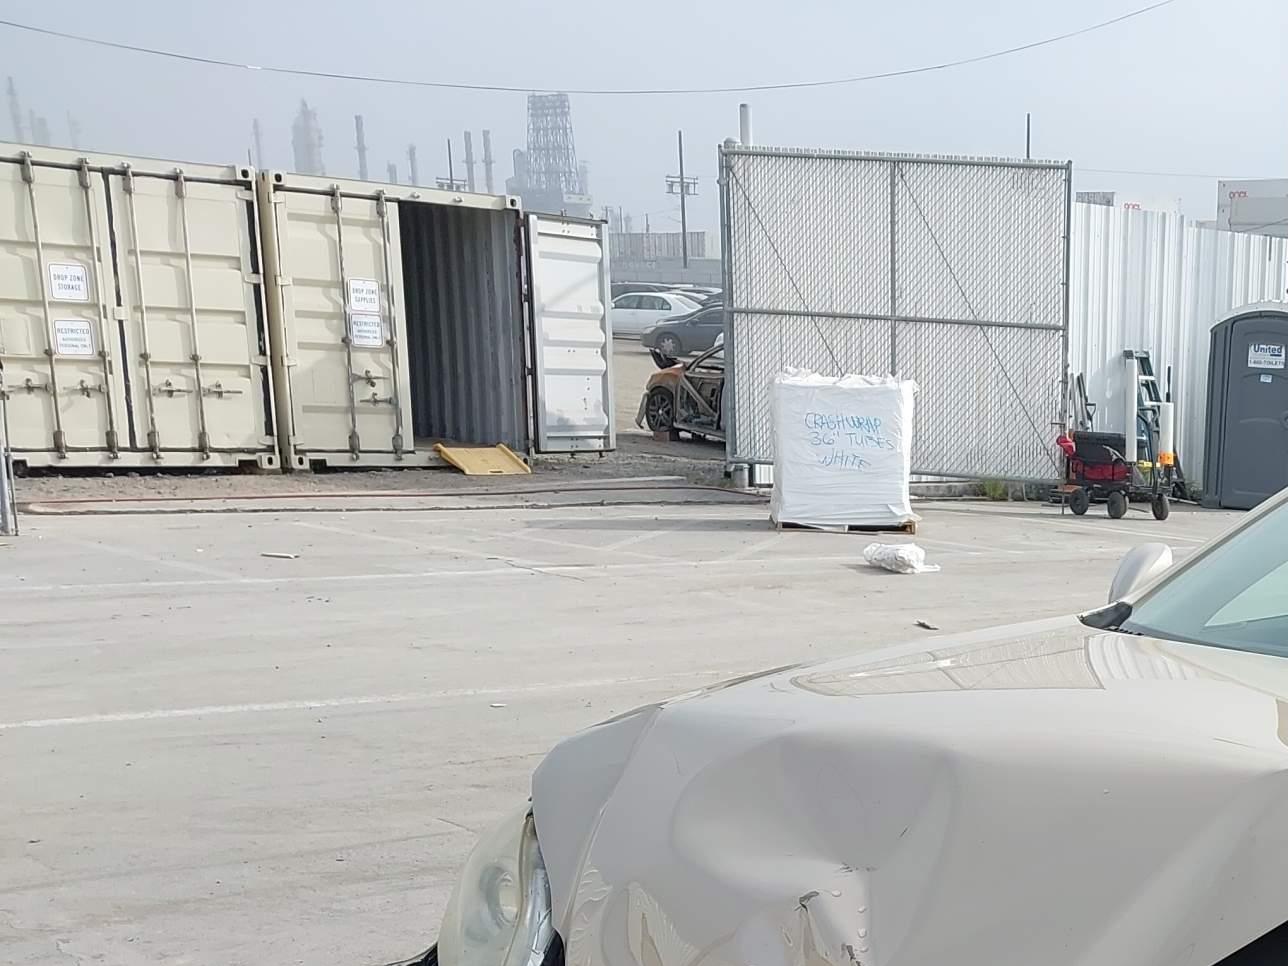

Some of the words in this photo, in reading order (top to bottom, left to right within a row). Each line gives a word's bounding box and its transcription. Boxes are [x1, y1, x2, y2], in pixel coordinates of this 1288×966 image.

[58, 283, 81, 291] STORAGE
[57, 327, 89, 335] RESTRICTED
[1253, 343, 1282, 354] United
